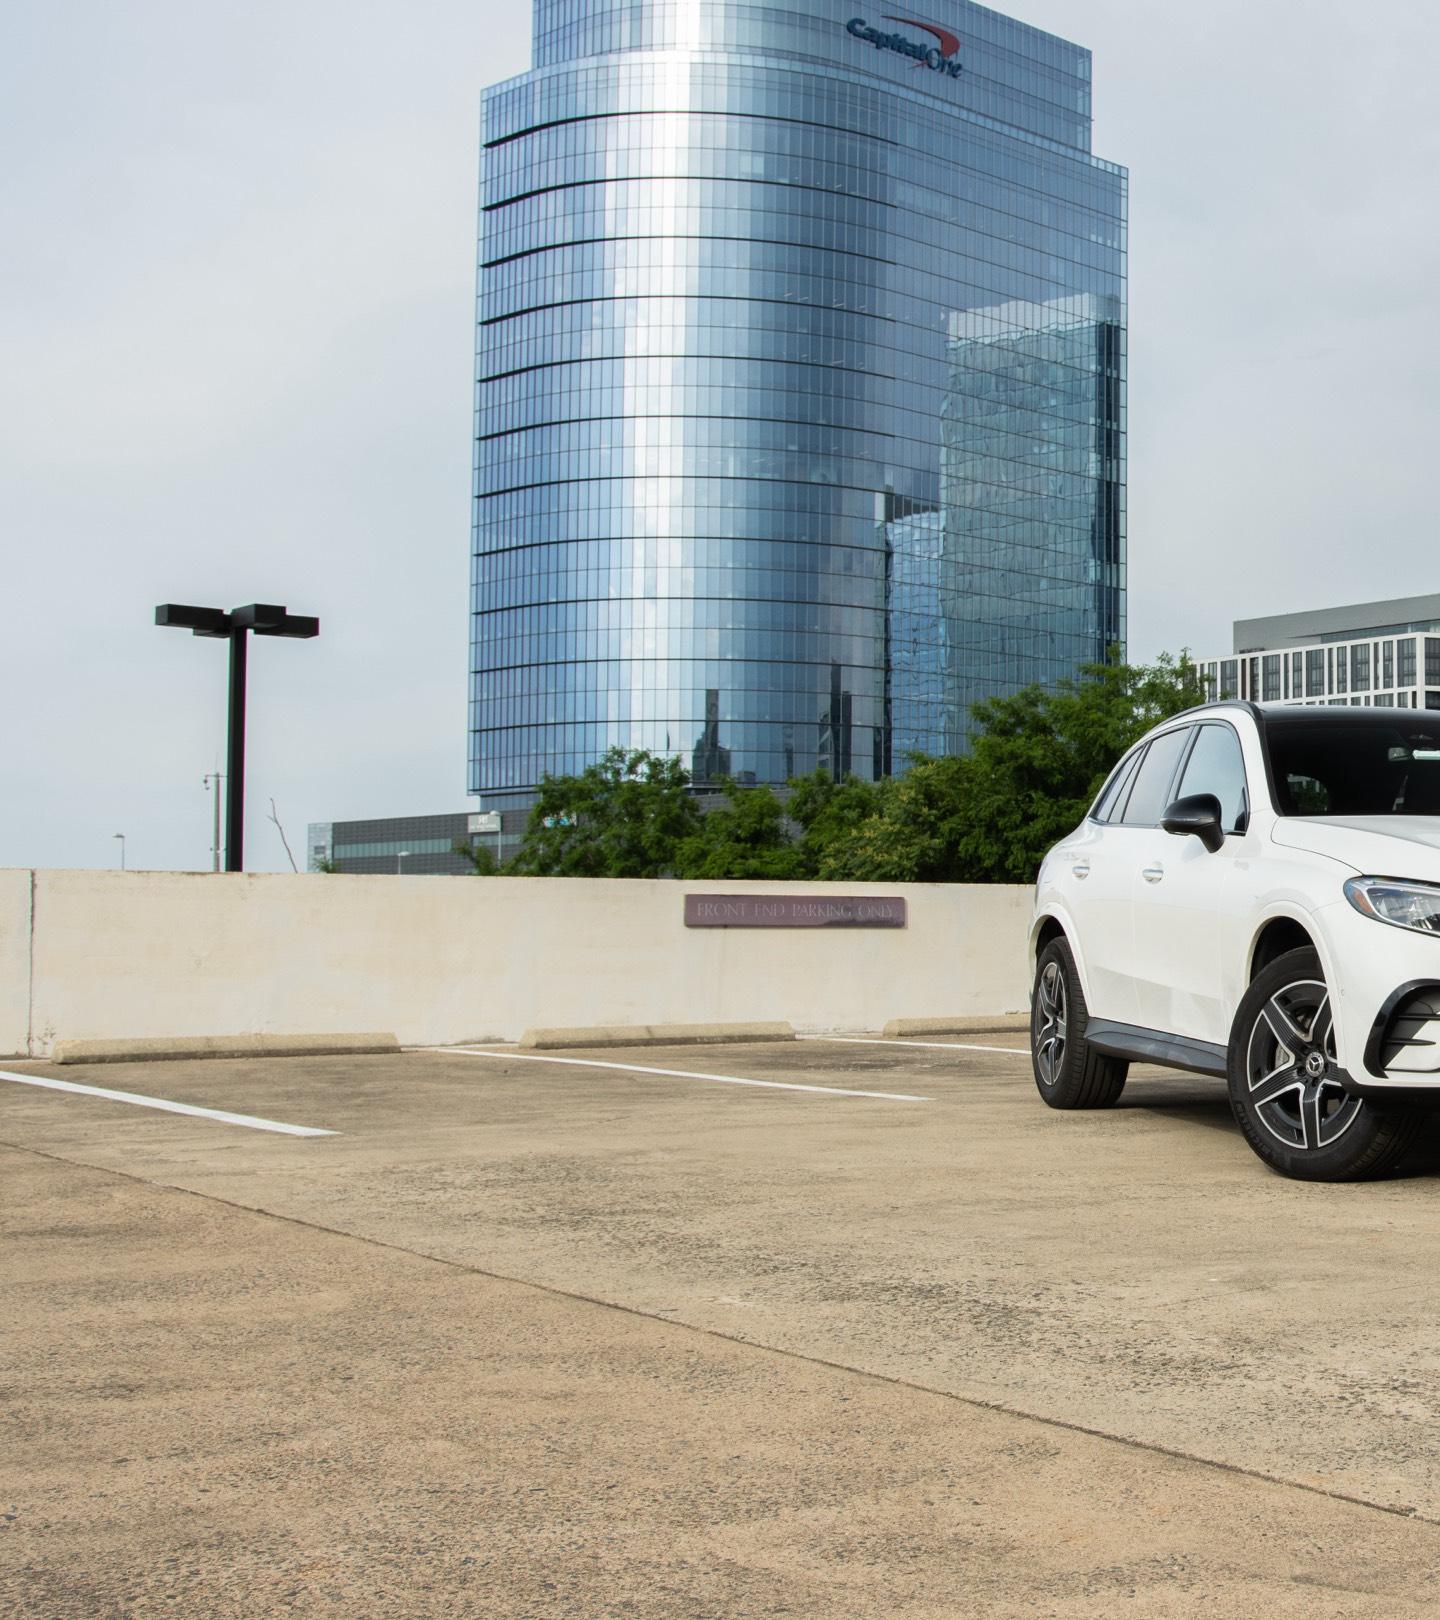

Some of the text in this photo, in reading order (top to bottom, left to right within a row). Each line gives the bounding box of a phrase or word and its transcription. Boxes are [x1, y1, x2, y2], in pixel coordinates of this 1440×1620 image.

[697, 902, 893, 919] FRONT END PARKING ONLY
